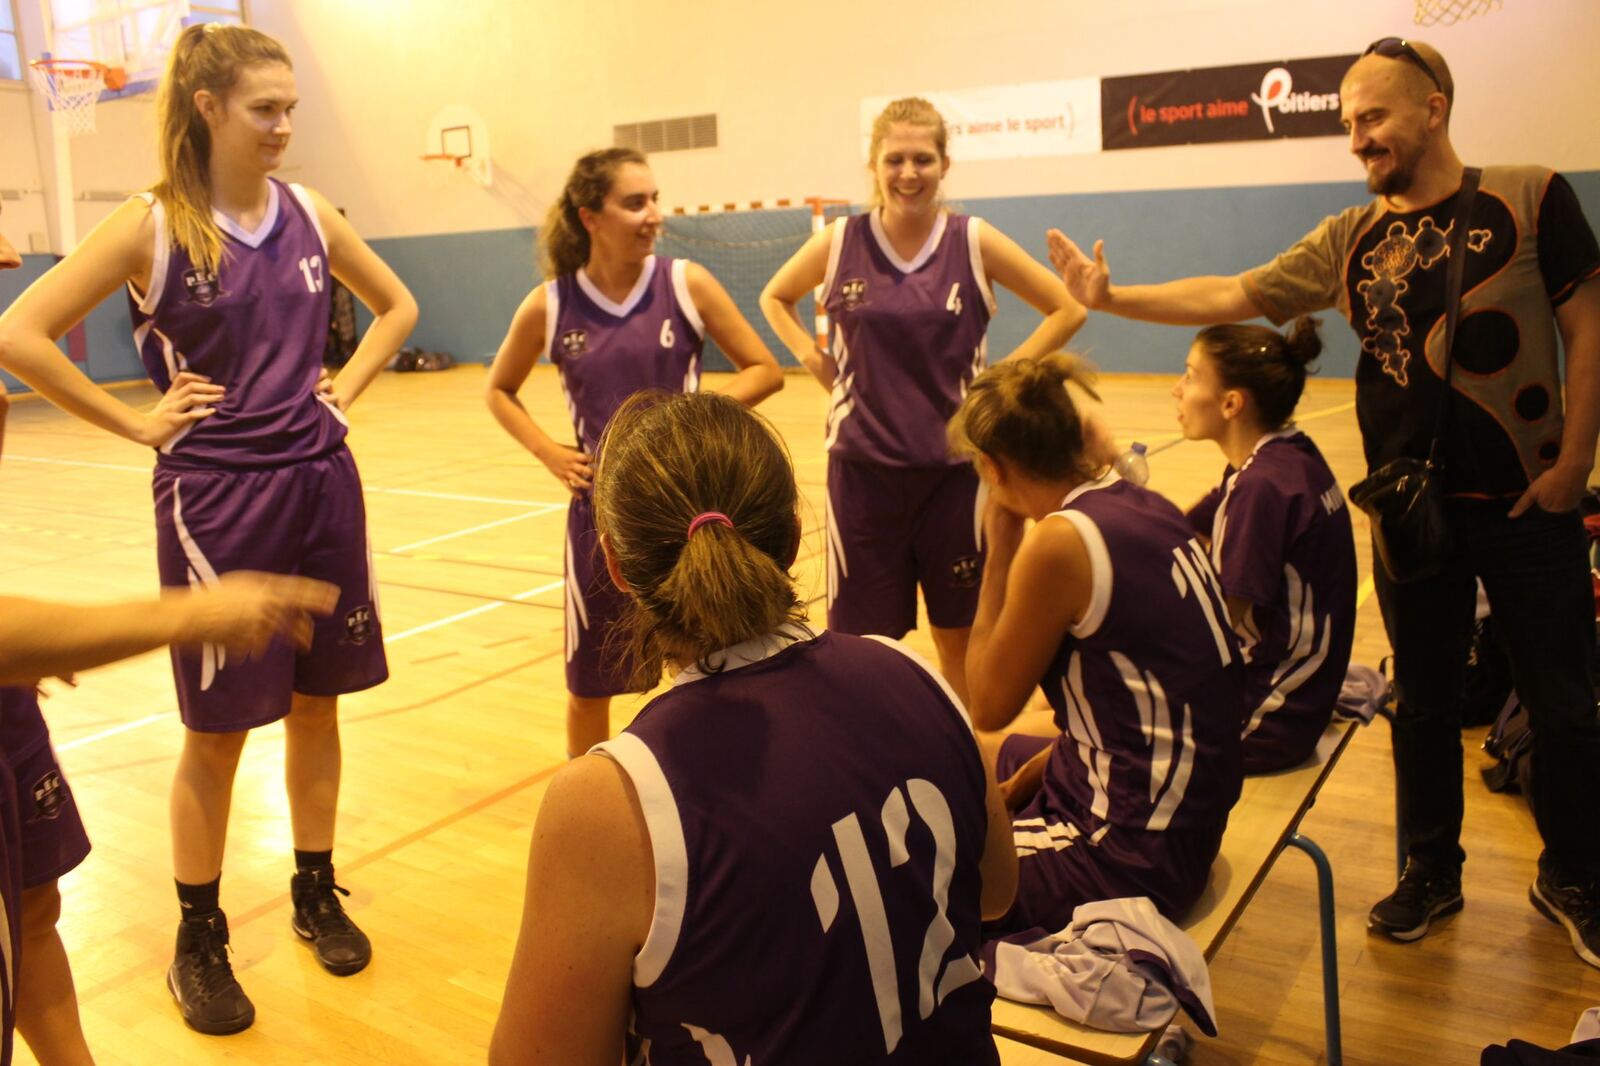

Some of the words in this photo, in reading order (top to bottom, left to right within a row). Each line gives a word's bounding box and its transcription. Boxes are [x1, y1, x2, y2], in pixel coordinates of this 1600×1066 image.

[1159, 102, 1204, 124] sport
[1206, 99, 1249, 119] aime
[1251, 67, 1340, 133] Poitiers
[967, 121, 1003, 134] aime
[946, 281, 963, 316] 4
[659, 318, 676, 349] 6
[810, 777, 983, 1055] 12
